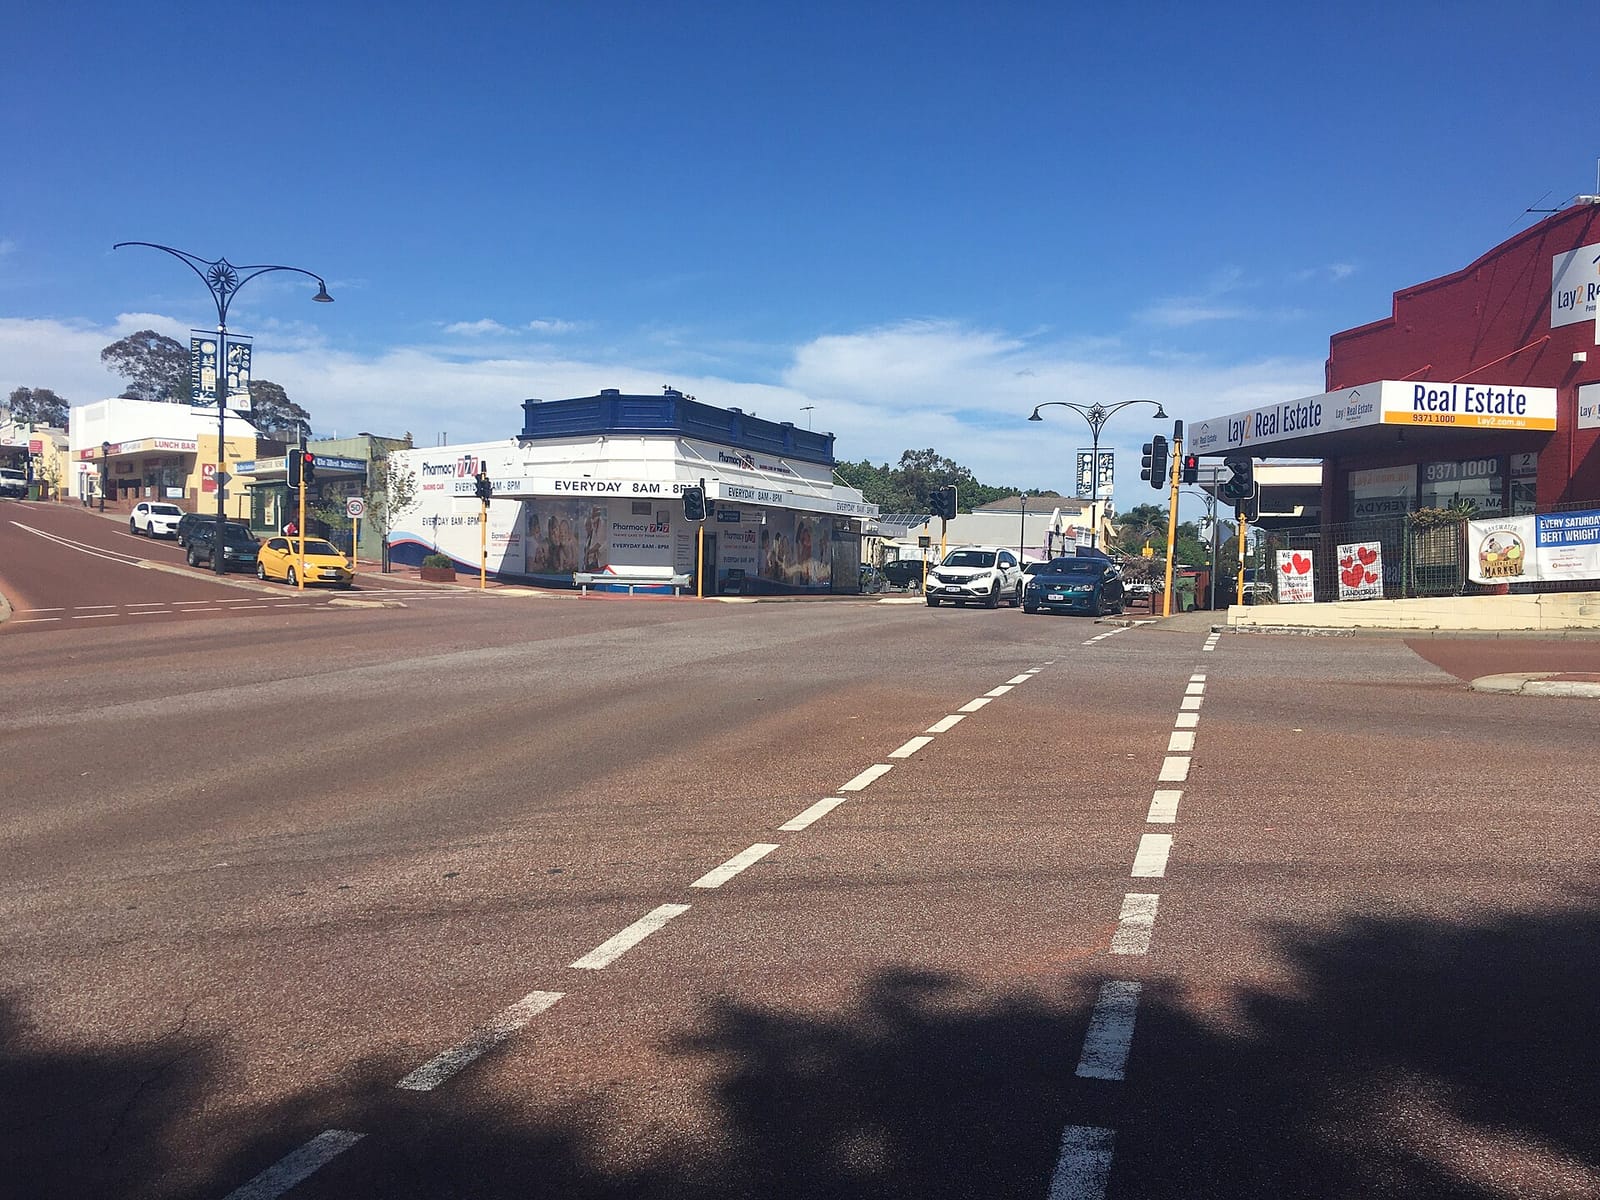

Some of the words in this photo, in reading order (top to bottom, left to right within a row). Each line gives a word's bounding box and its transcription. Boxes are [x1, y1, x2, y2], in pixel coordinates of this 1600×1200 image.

[1557, 284, 1584, 310] Lay2
[1413, 384, 1457, 412] Real
[1464, 386, 1527, 415] Estate
[1346, 404, 1358, 416] Real
[1357, 402, 1374, 415] Estate
[1580, 404, 1597, 418] Lay2
[1227, 414, 1252, 446] Lay2
[1255, 405, 1280, 438] Real
[1283, 399, 1322, 432] Estate
[1412, 413, 1433, 422] 9371
[1435, 414, 1456, 423] 1000
[1477, 416, 1527, 427] Lay2.com.au
[154, 440, 180, 449] LUNCH
[180, 441, 196, 450] BAR
[718, 450, 742, 469] Pharmacy
[1522, 454, 1531, 466] 2
[422, 460, 457, 478] Pharmacy
[457, 454, 479, 478] 777
[1427, 463, 1457, 480] 9371
[1461, 458, 1498, 477] 1000
[455, 481, 477, 492] EVERYD
[507, 480, 521, 491] 8PM
[554, 480, 622, 492] EVERYDAY
[632, 482, 660, 494] 8AM
[728, 487, 755, 499] EVERYDAY
[757, 490, 769, 501] 8AM
[772, 493, 783, 503] 8PM
[350, 504, 361, 512] 50
[451, 516, 463, 526] 8AM
[467, 516, 480, 526] 8PM
[1540, 518, 1564, 529] EVERY
[612, 522, 648, 533] Pharmacy
[650, 522, 670, 533] 777
[1483, 524, 1518, 534] BAYSWATER
[1540, 531, 1563, 543] BERT
[1564, 528, 1600, 542] WRIGHT
[1281, 551, 1291, 559] WE
[1343, 546, 1353, 555] WE
[1484, 563, 1519, 577] MARKET
[1342, 588, 1378, 597] LANDLORDS
